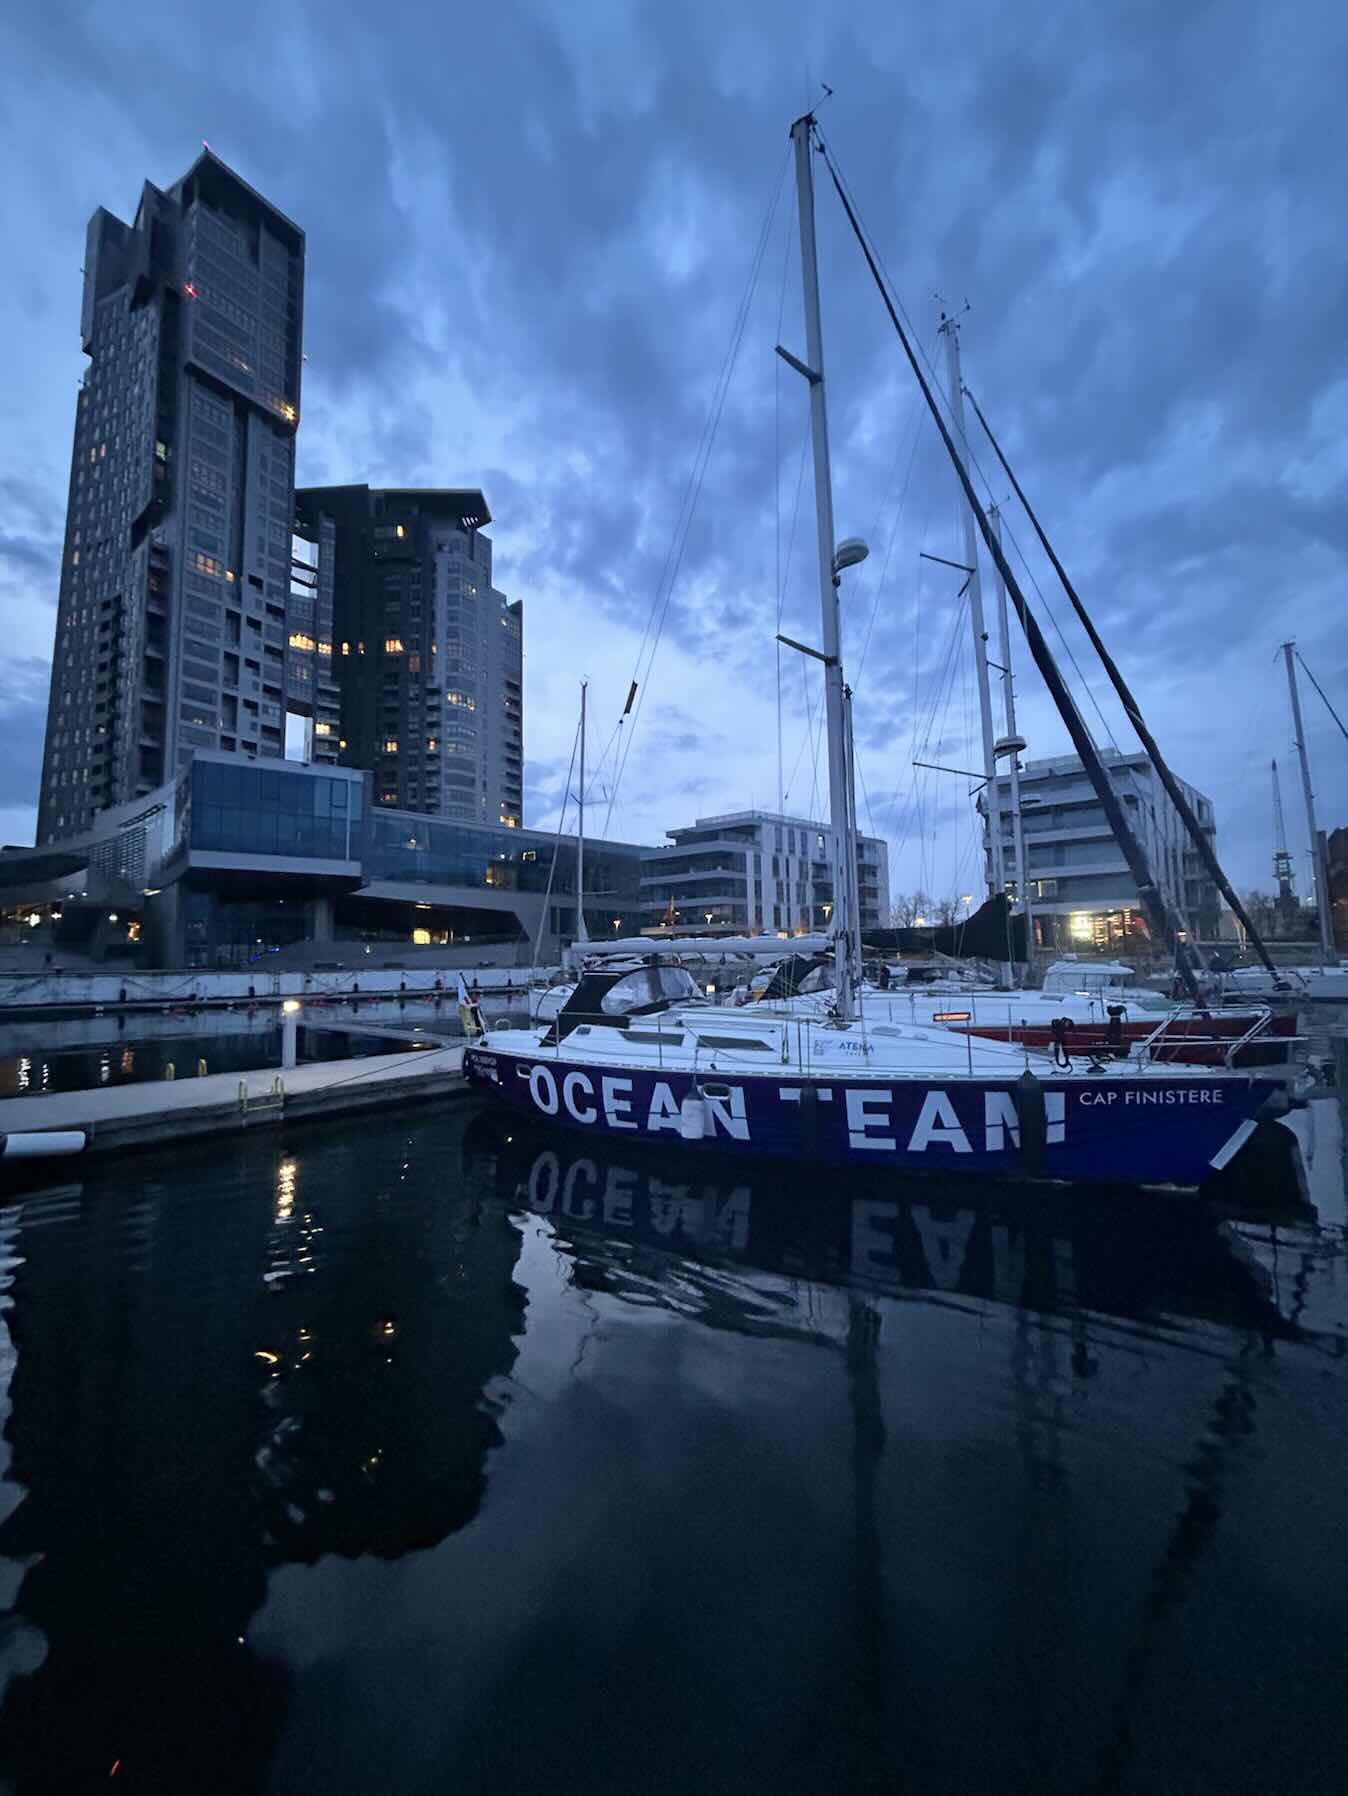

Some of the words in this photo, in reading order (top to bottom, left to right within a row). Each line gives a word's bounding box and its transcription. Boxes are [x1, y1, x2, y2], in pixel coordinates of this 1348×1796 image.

[529, 1065, 751, 1140] OCEAN
[1079, 1091, 1117, 1105] CAP
[1125, 1089, 1224, 1105] FINISTERE
